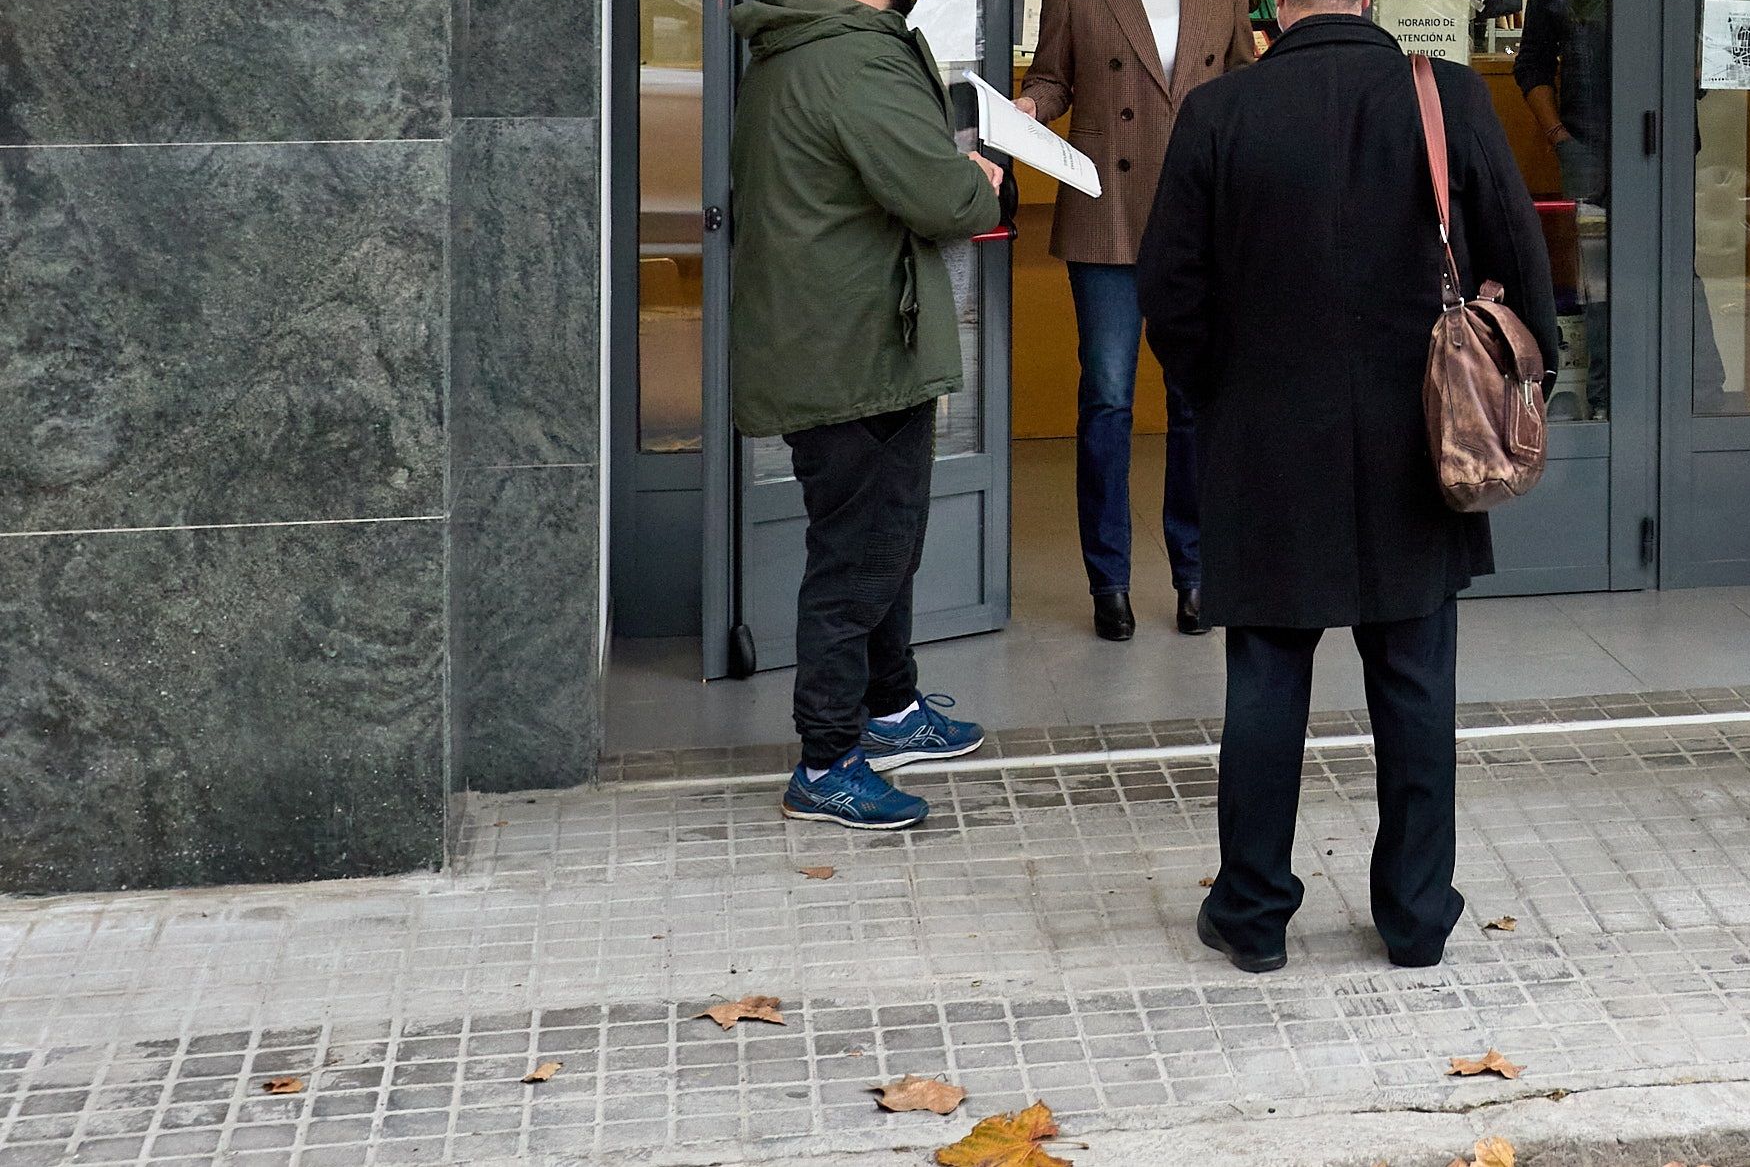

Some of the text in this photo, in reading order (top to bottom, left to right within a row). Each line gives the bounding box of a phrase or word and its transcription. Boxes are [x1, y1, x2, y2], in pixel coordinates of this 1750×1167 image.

[1398, 18, 1455, 26] HORARIO DE
[1397, 32, 1456, 42] ATENCIÓN AL
